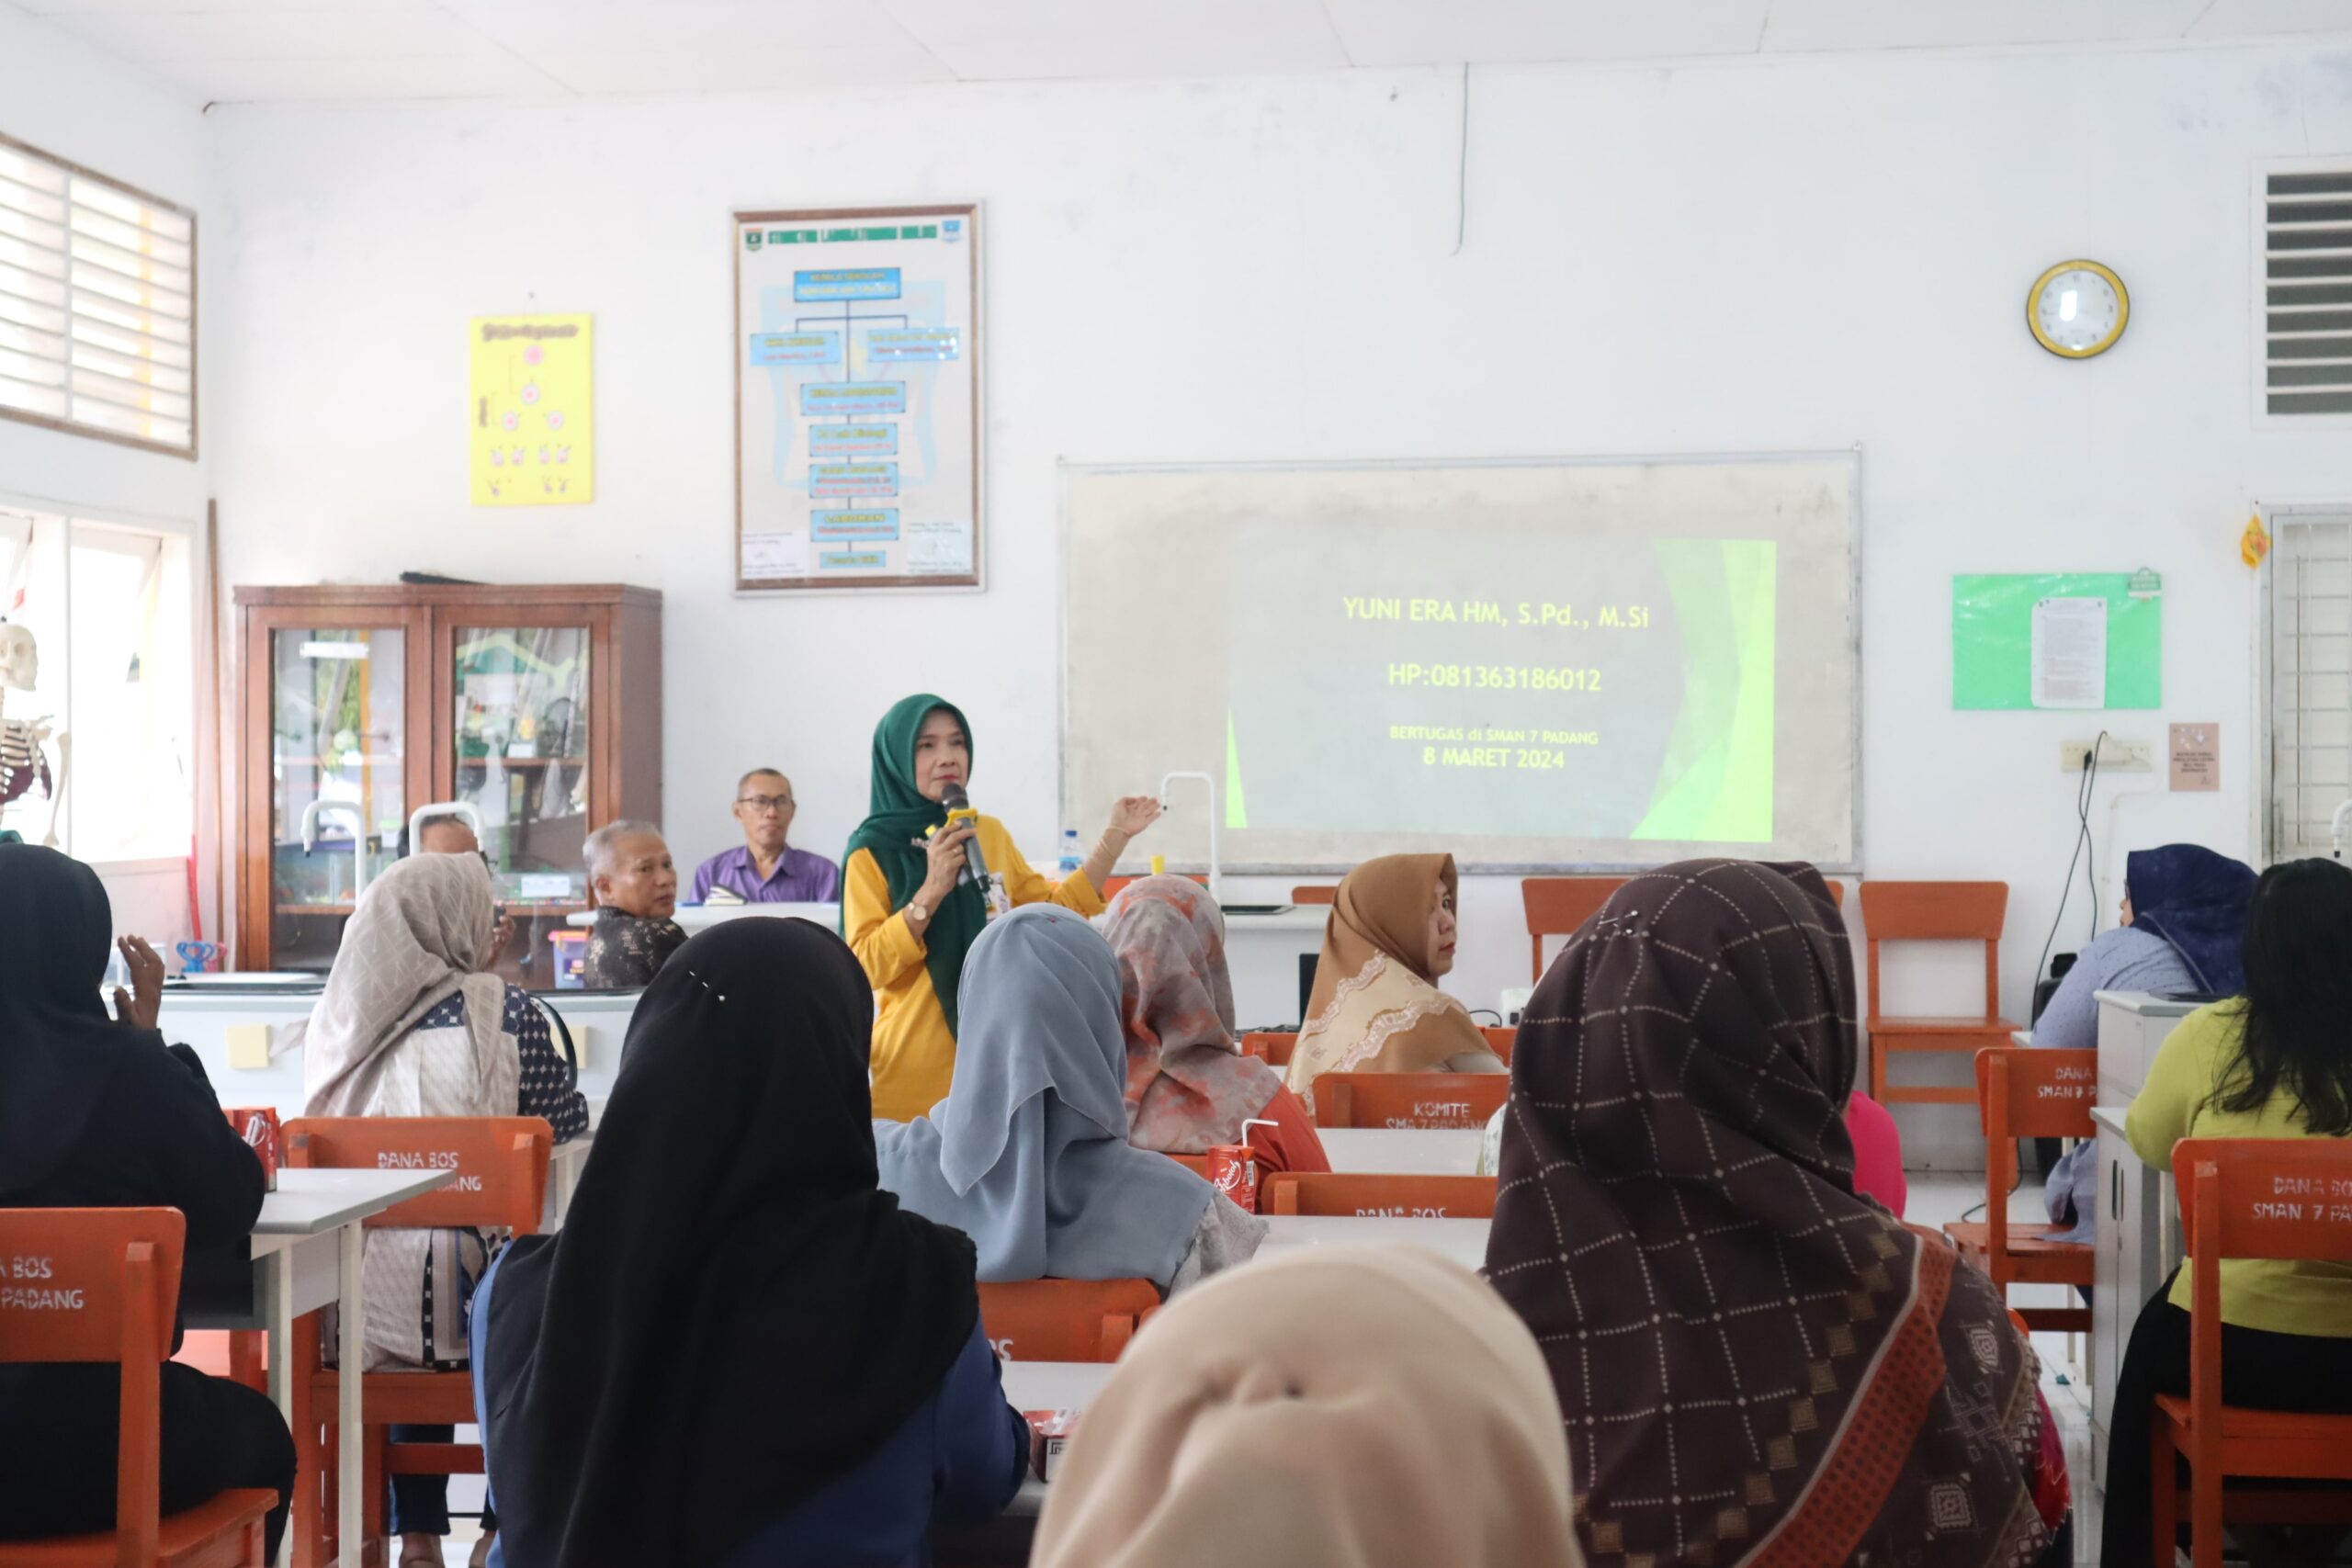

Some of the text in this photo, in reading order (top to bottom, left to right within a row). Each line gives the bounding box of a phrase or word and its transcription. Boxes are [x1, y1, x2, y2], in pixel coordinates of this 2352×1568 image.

[1342, 596, 1649, 630] YUNI ERA HM, S.Pd., M.Si
[1388, 663, 1602, 692] HP:081363186012
[1390, 726, 1599, 745] BERTUGAS di SMAN 7 PADANG
[1423, 746, 1565, 769] 8 MARET 2024
[2055, 1066, 2093, 1080] DANA
[2037, 1085, 2073, 1099] SMAN
[1414, 1102, 1471, 1117] KOMITE
[378, 1152, 458, 1168] DANA BOS
[2273, 1177, 2324, 1195] DANA
[2253, 1202, 2301, 1220] SMAN
[2312, 1204, 2324, 1221] 7
[13, 1258, 52, 1279] BOS
[0, 1289, 85, 1309] PADANG
